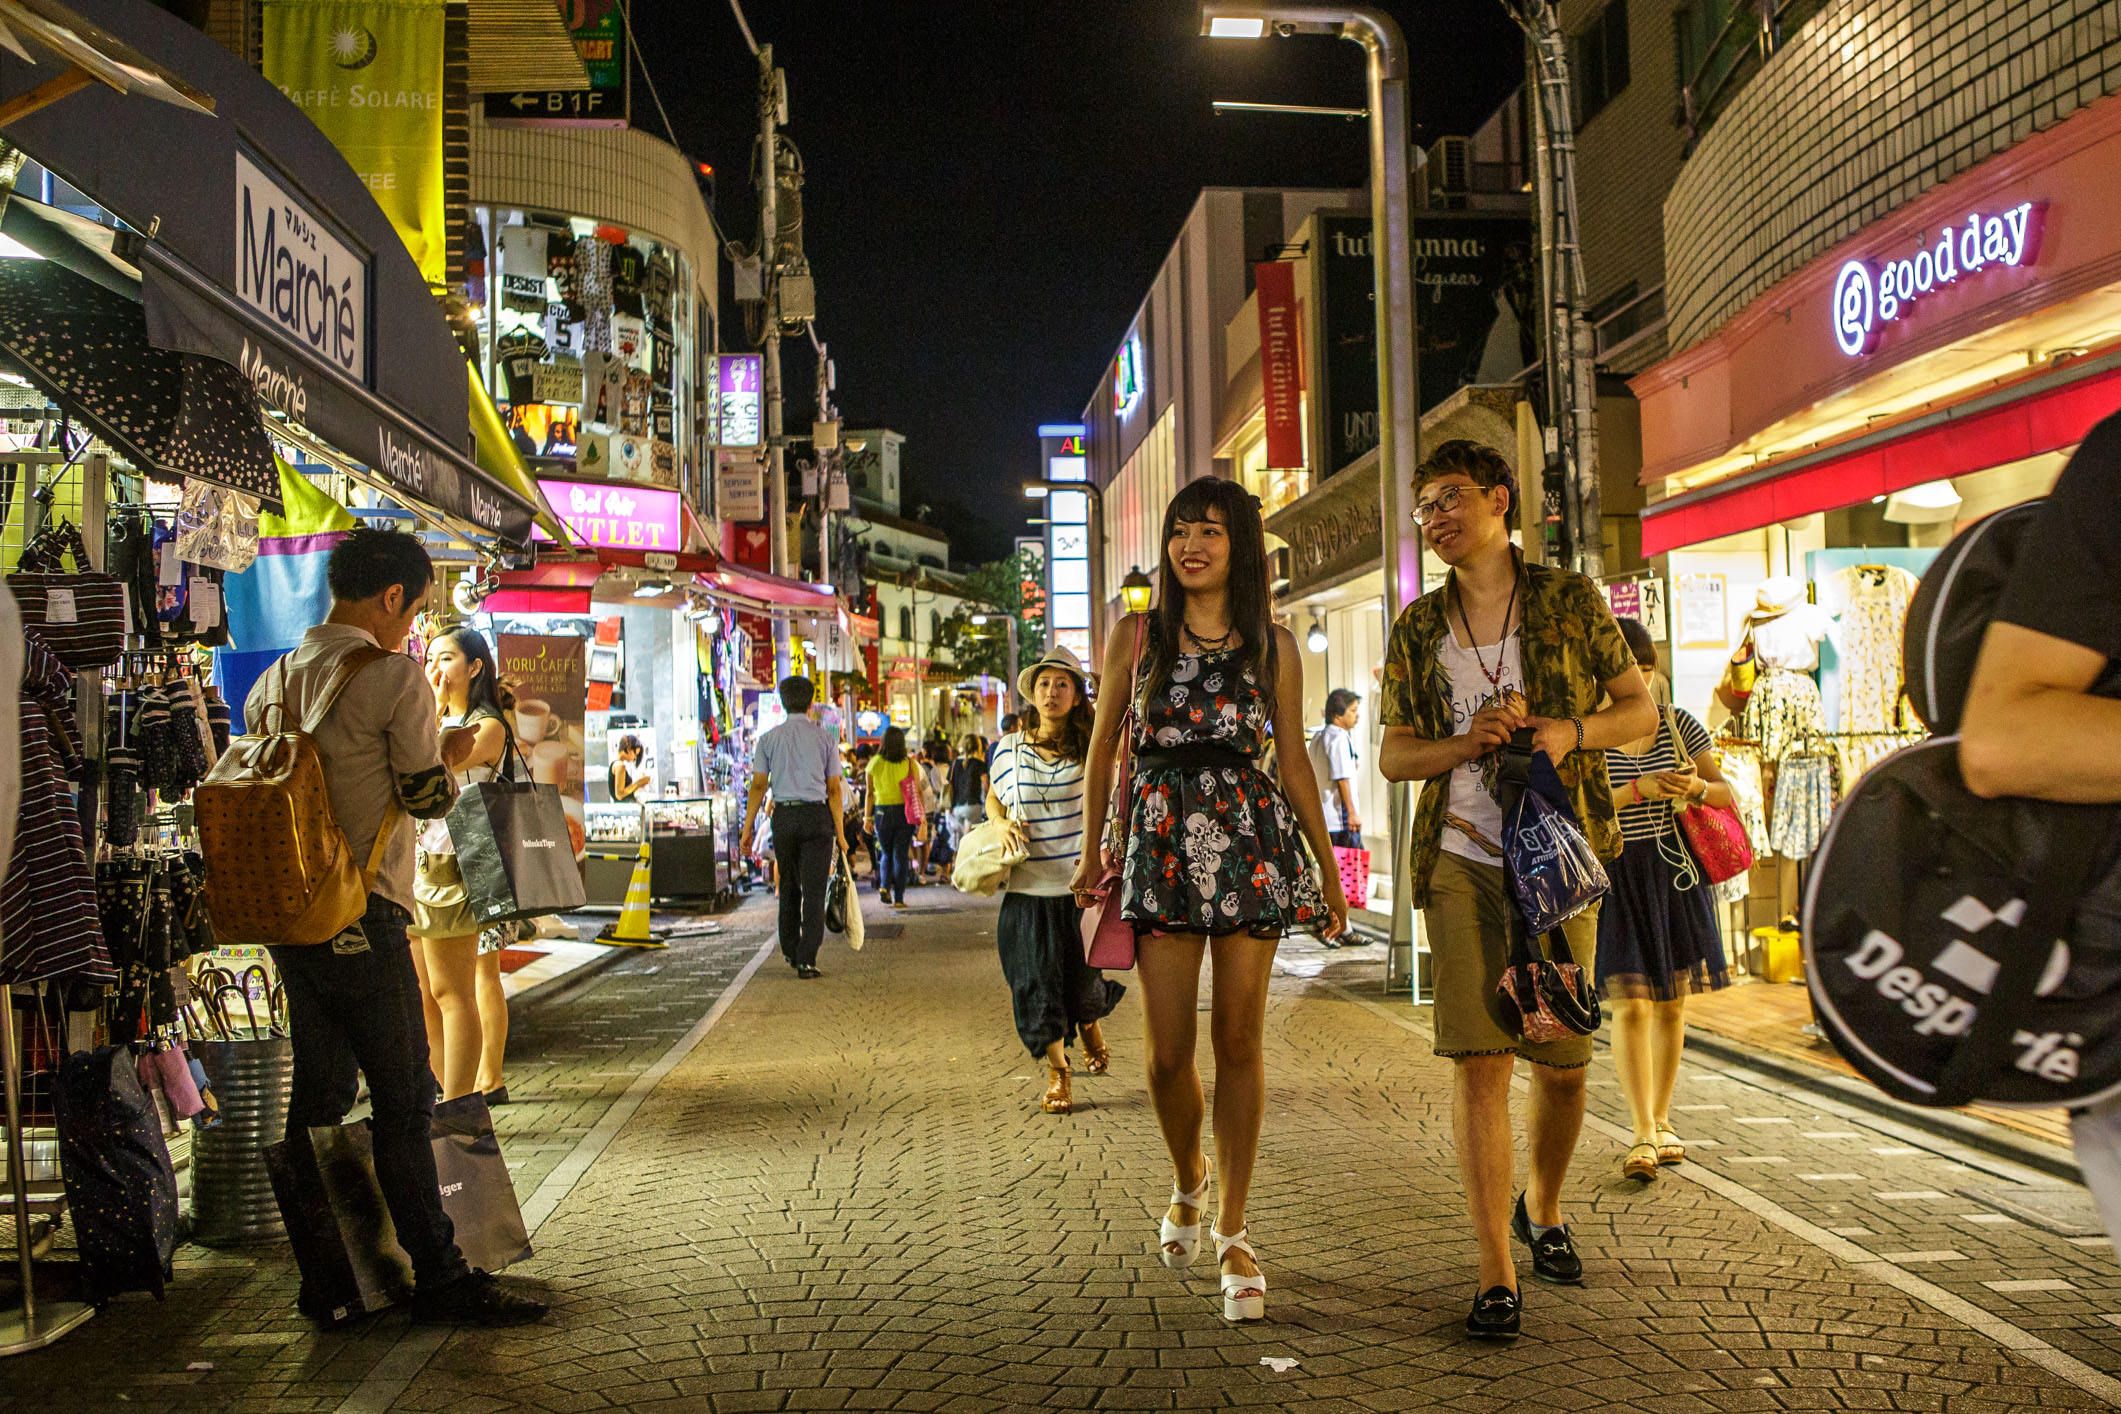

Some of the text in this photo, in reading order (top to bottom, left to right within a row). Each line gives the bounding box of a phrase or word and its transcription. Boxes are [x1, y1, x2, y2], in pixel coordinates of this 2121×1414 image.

[350, 85, 437, 109] SOLARE
[284, 206, 317, 251] マルシェ
[242, 184, 355, 370] Marché
[240, 337, 307, 426] Marché
[379, 425, 424, 492] Marché
[541, 516, 665, 547] UTLET
[506, 656, 578, 673] YORU CAFFE
[221, 948, 265, 958] MELODY
